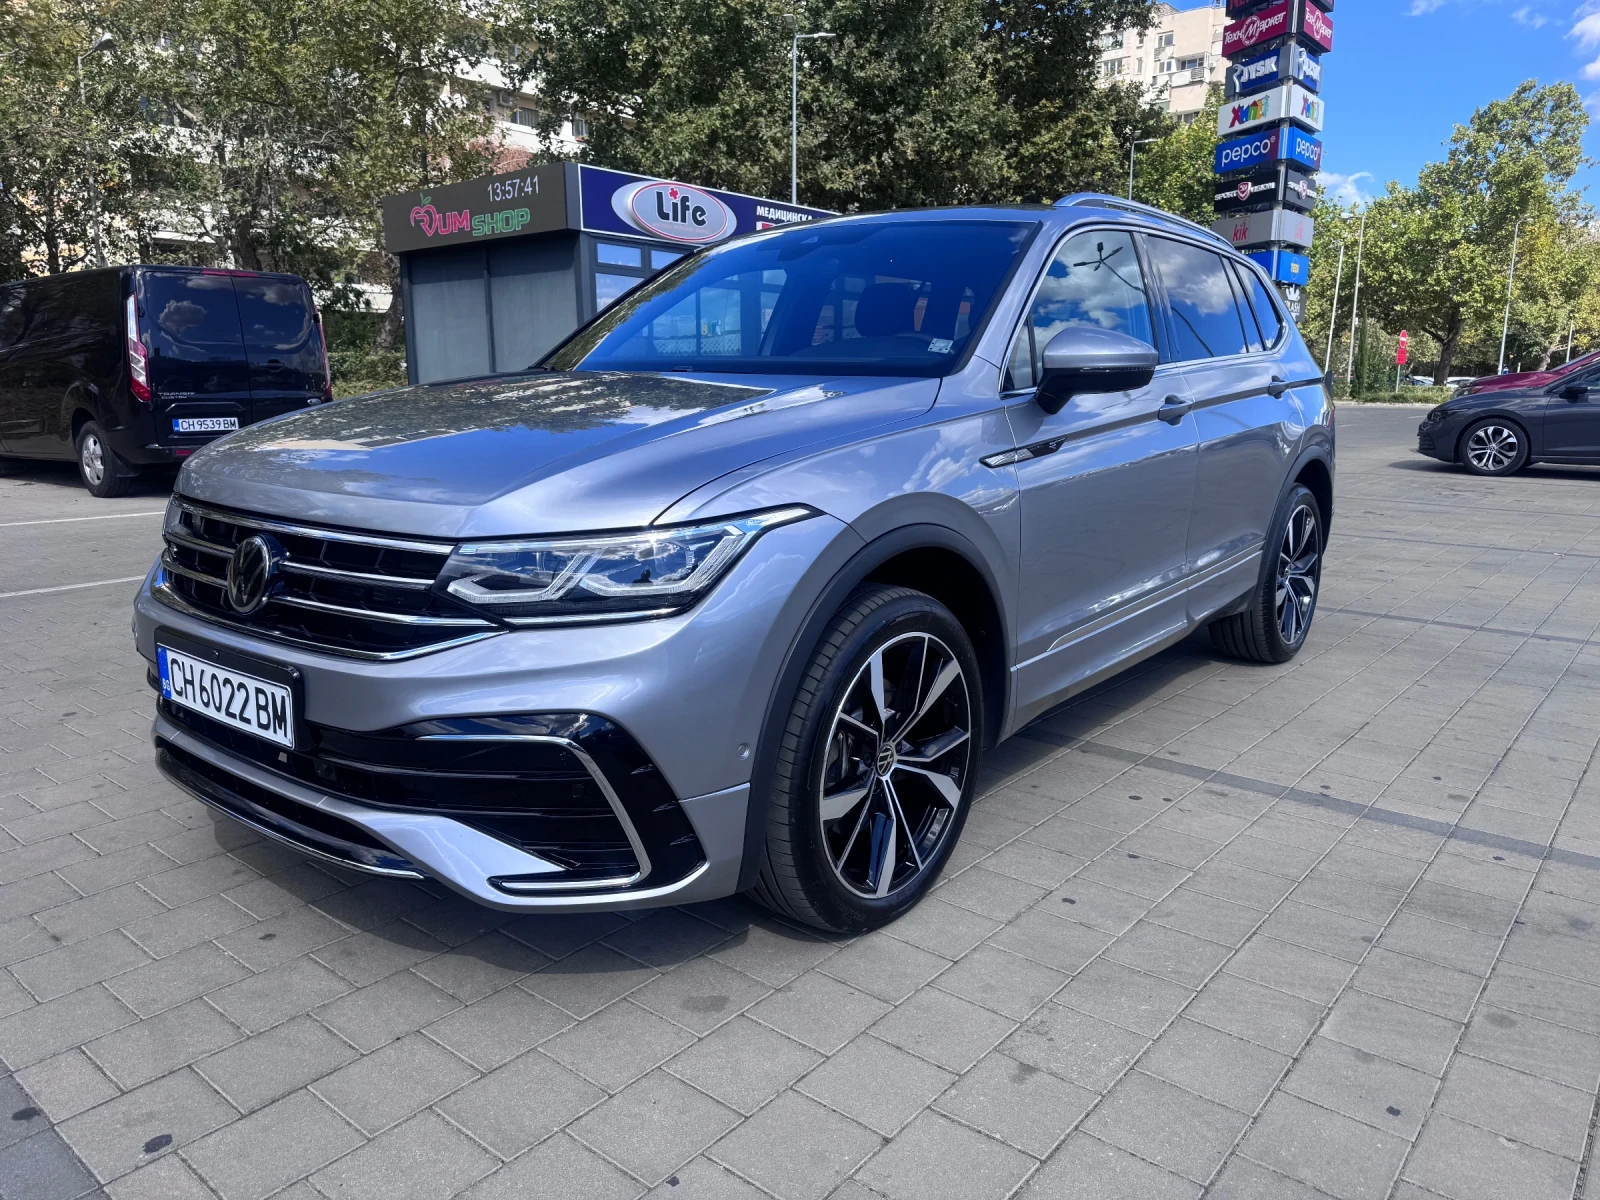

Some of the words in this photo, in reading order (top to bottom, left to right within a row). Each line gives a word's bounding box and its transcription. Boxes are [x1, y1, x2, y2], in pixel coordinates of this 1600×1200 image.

[1240, 56, 1278, 83] JYSK
[487, 175, 539, 202] 13:57:41
[1214, 190, 1238, 201] SPORT
[656, 187, 708, 227] Life
[471, 207, 531, 237] SHOP
[180, 420, 196, 431] CH
[196, 419, 222, 430] 9539
[222, 418, 238, 429] BM
[170, 657, 197, 704] CH
[199, 668, 252, 726] 6022
[254, 685, 288, 739] BM
